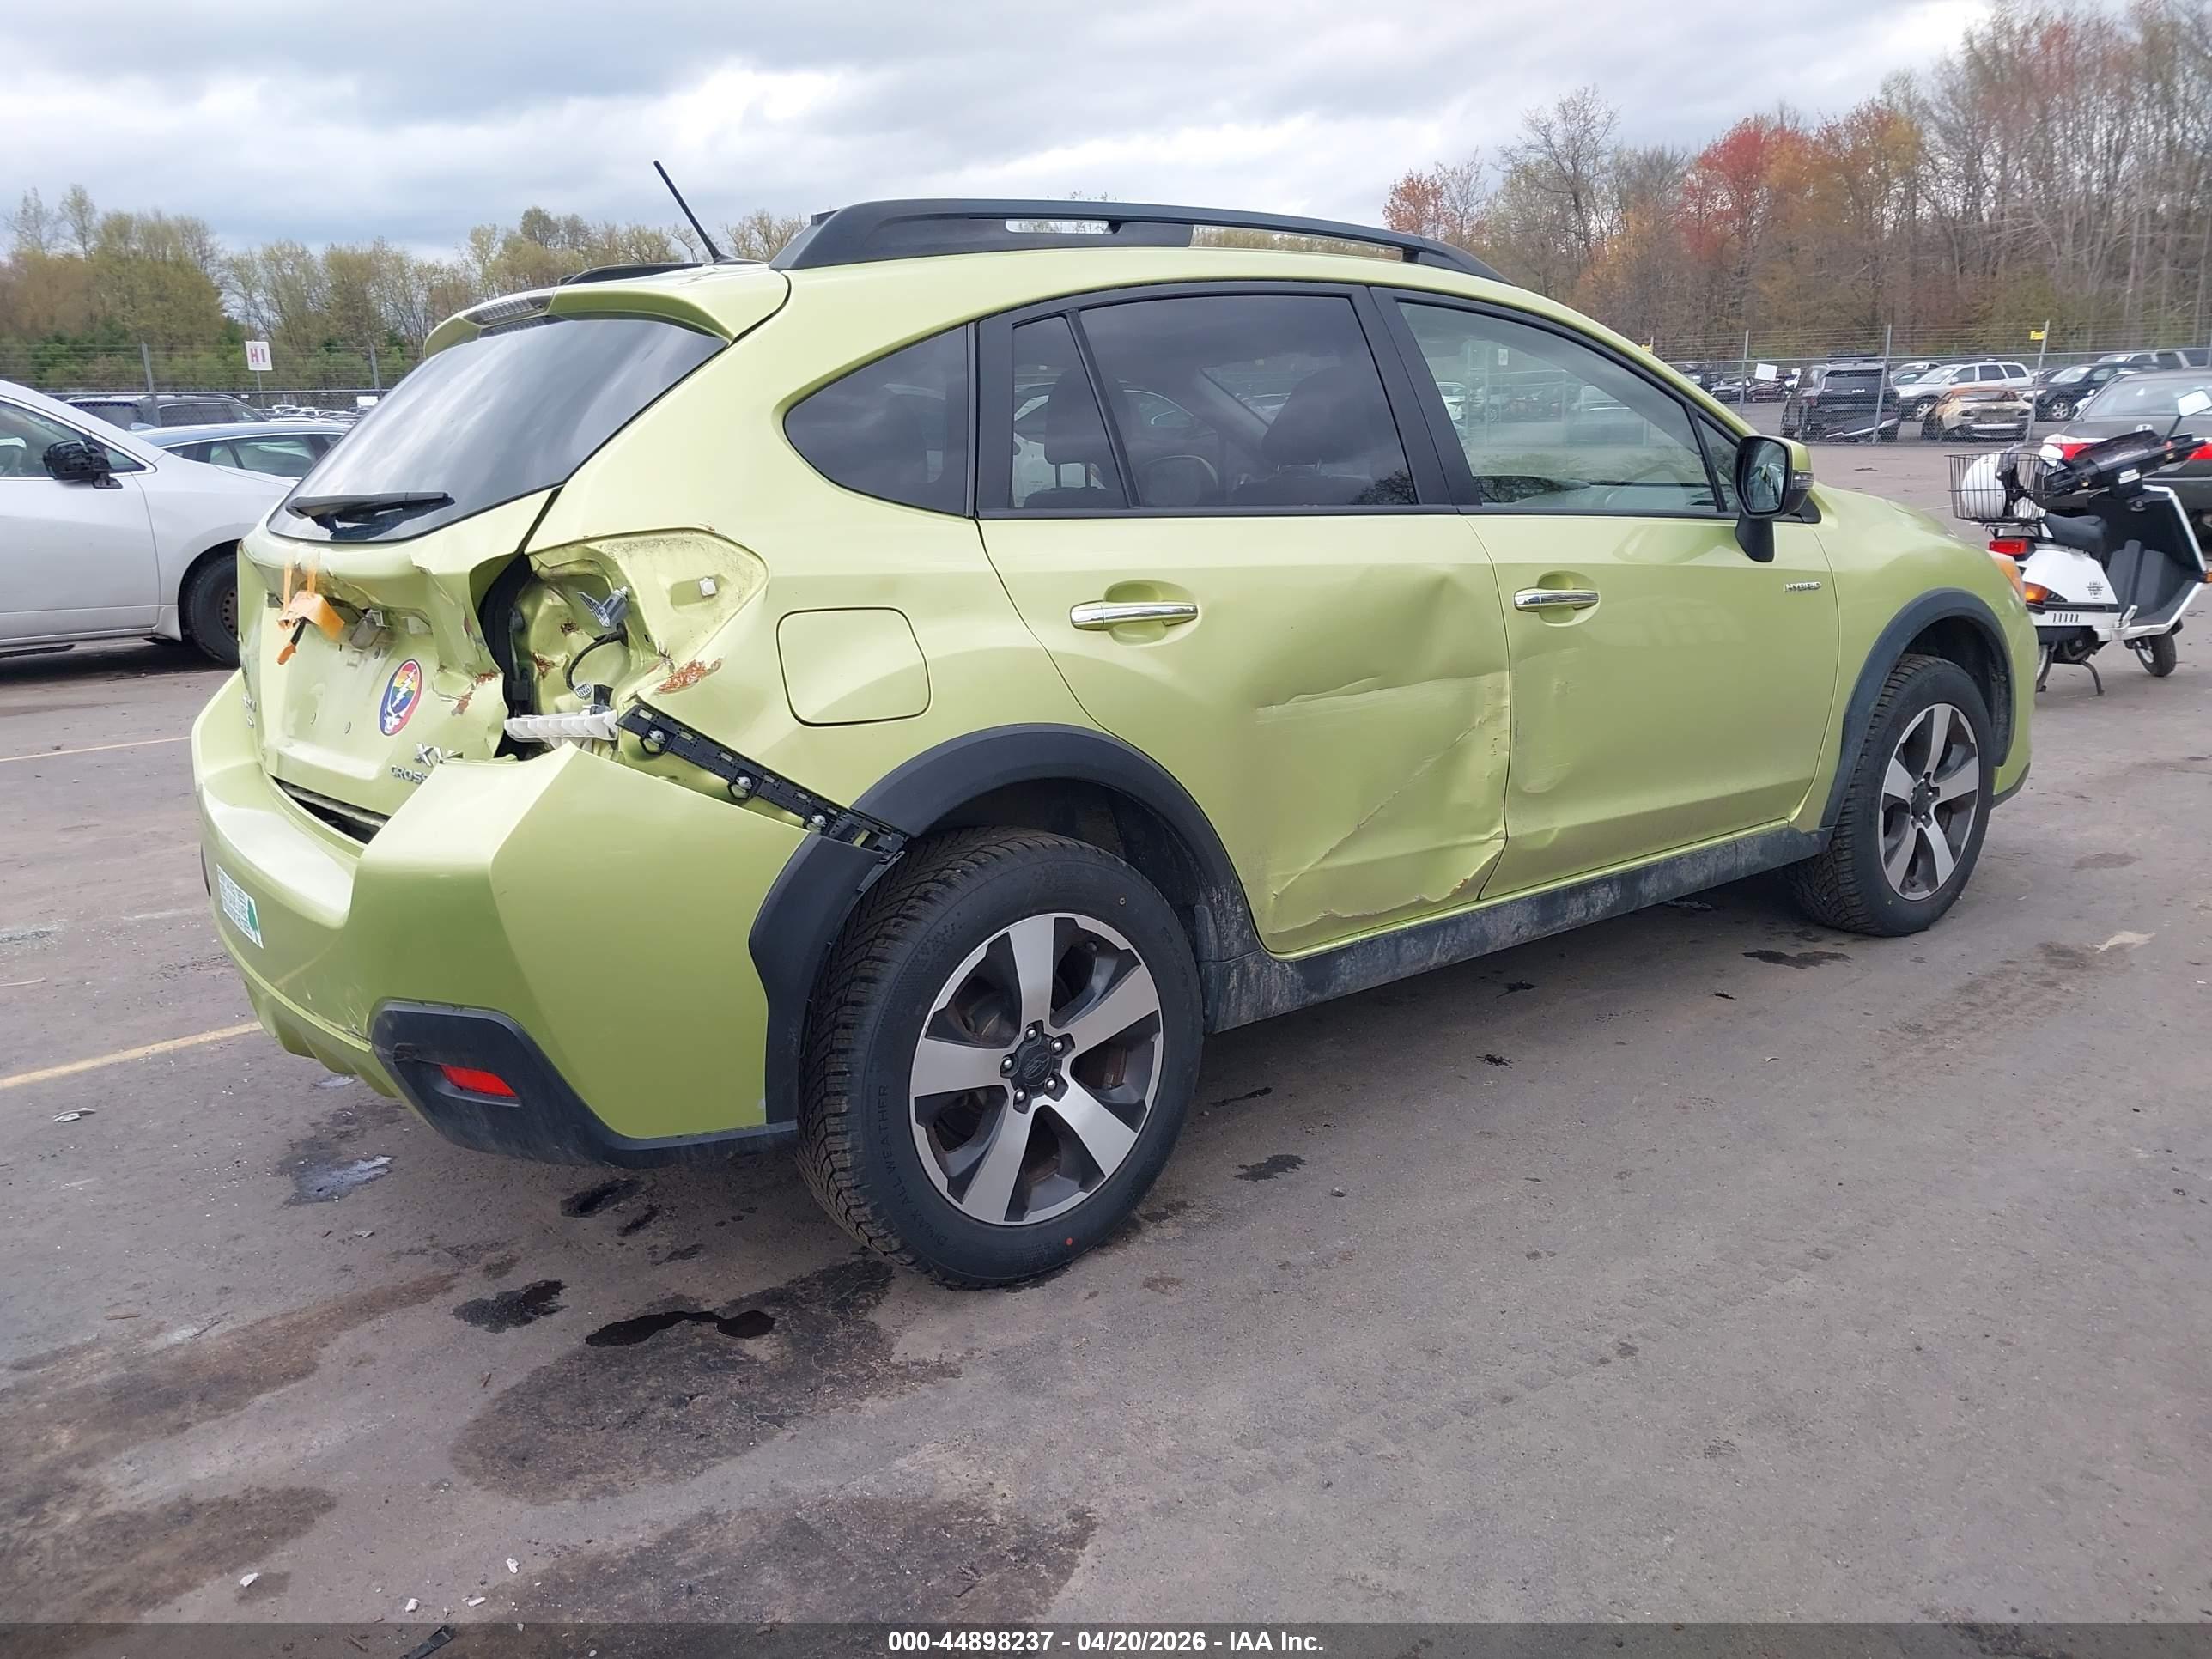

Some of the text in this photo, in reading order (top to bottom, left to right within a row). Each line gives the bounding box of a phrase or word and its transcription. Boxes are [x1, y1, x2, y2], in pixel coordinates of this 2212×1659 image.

[1784, 582, 1821, 592] HYBRID
[878, 1085, 897, 1175] WEATHER
[893, 1176, 914, 1205] ALL
